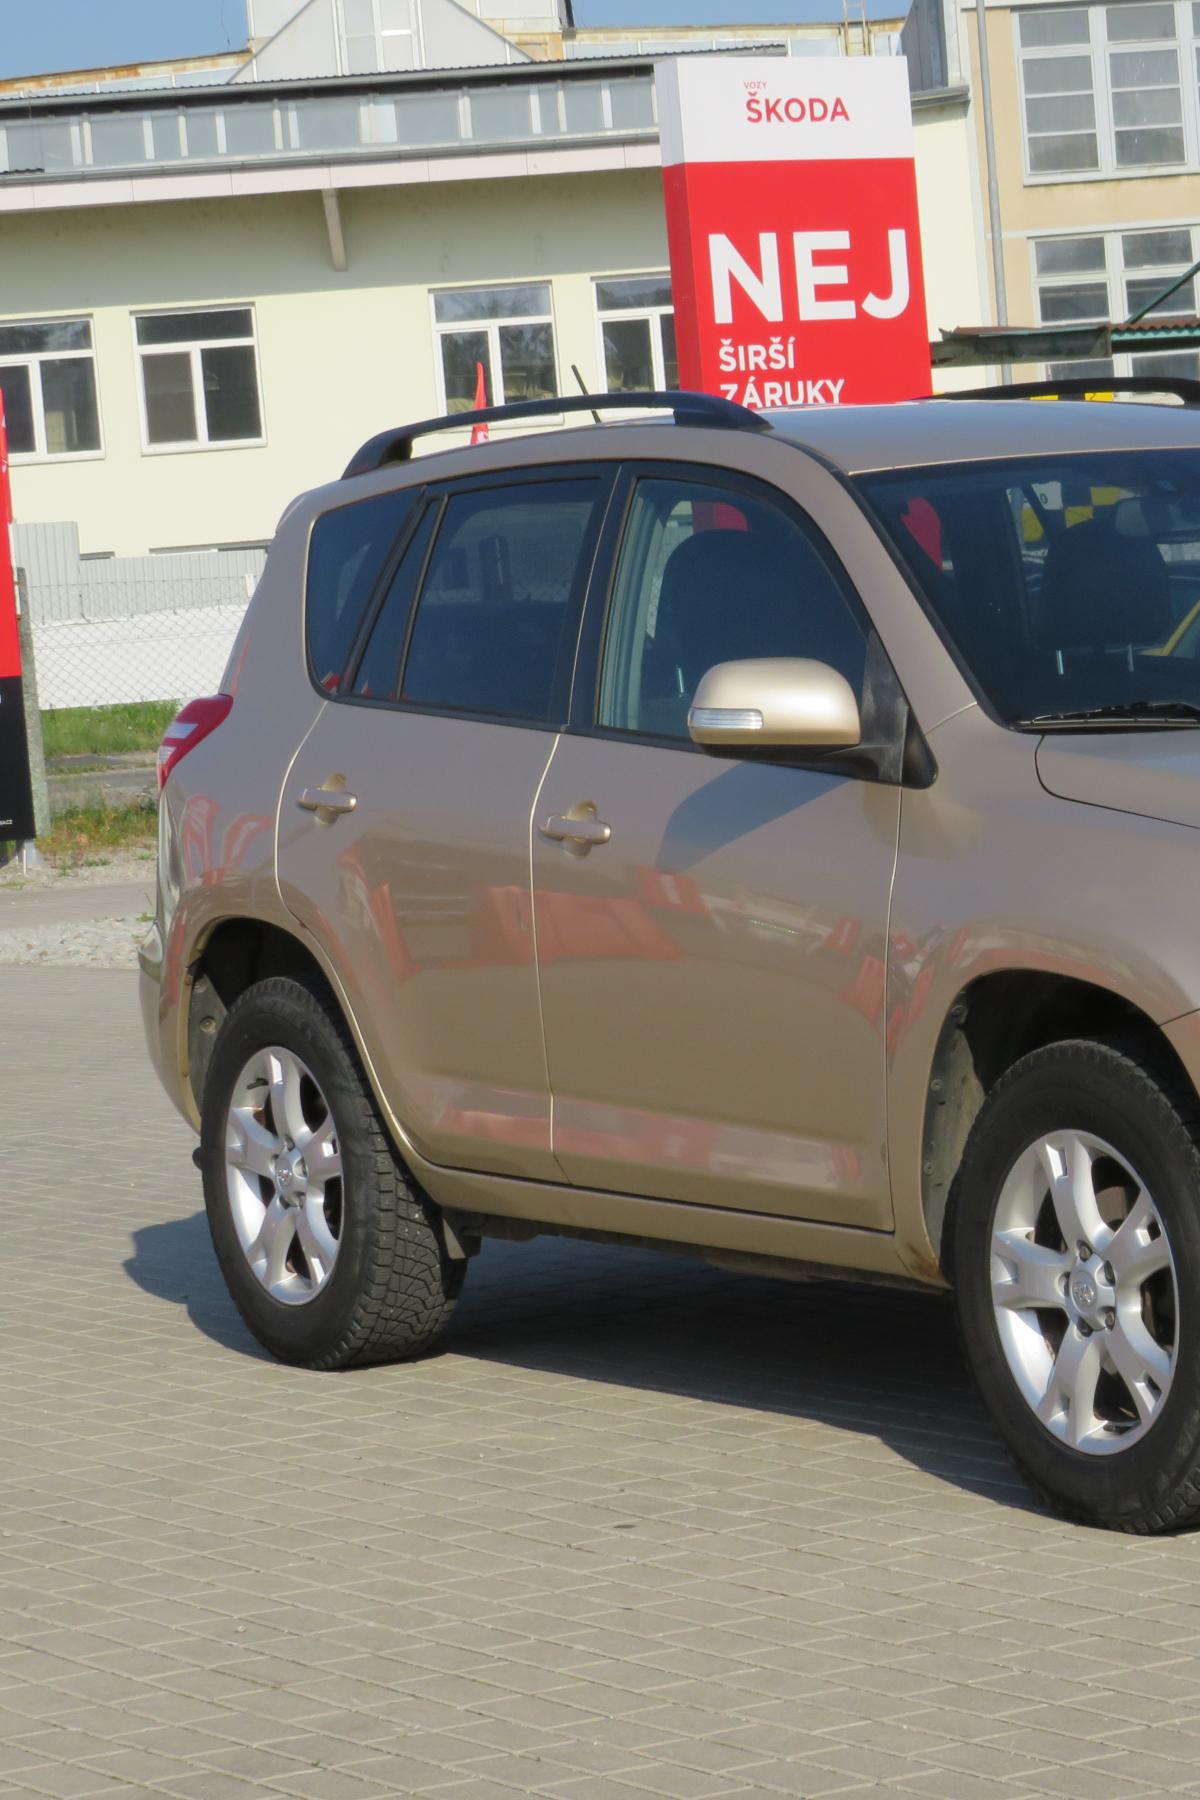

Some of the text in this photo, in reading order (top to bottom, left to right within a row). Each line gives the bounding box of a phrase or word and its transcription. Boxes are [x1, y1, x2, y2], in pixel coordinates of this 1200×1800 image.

[743, 80, 768, 90] VOZY
[746, 91, 850, 123] ŠKODA
[708, 229, 910, 325] NEJ
[719, 336, 796, 372] ŠIRŠÍ
